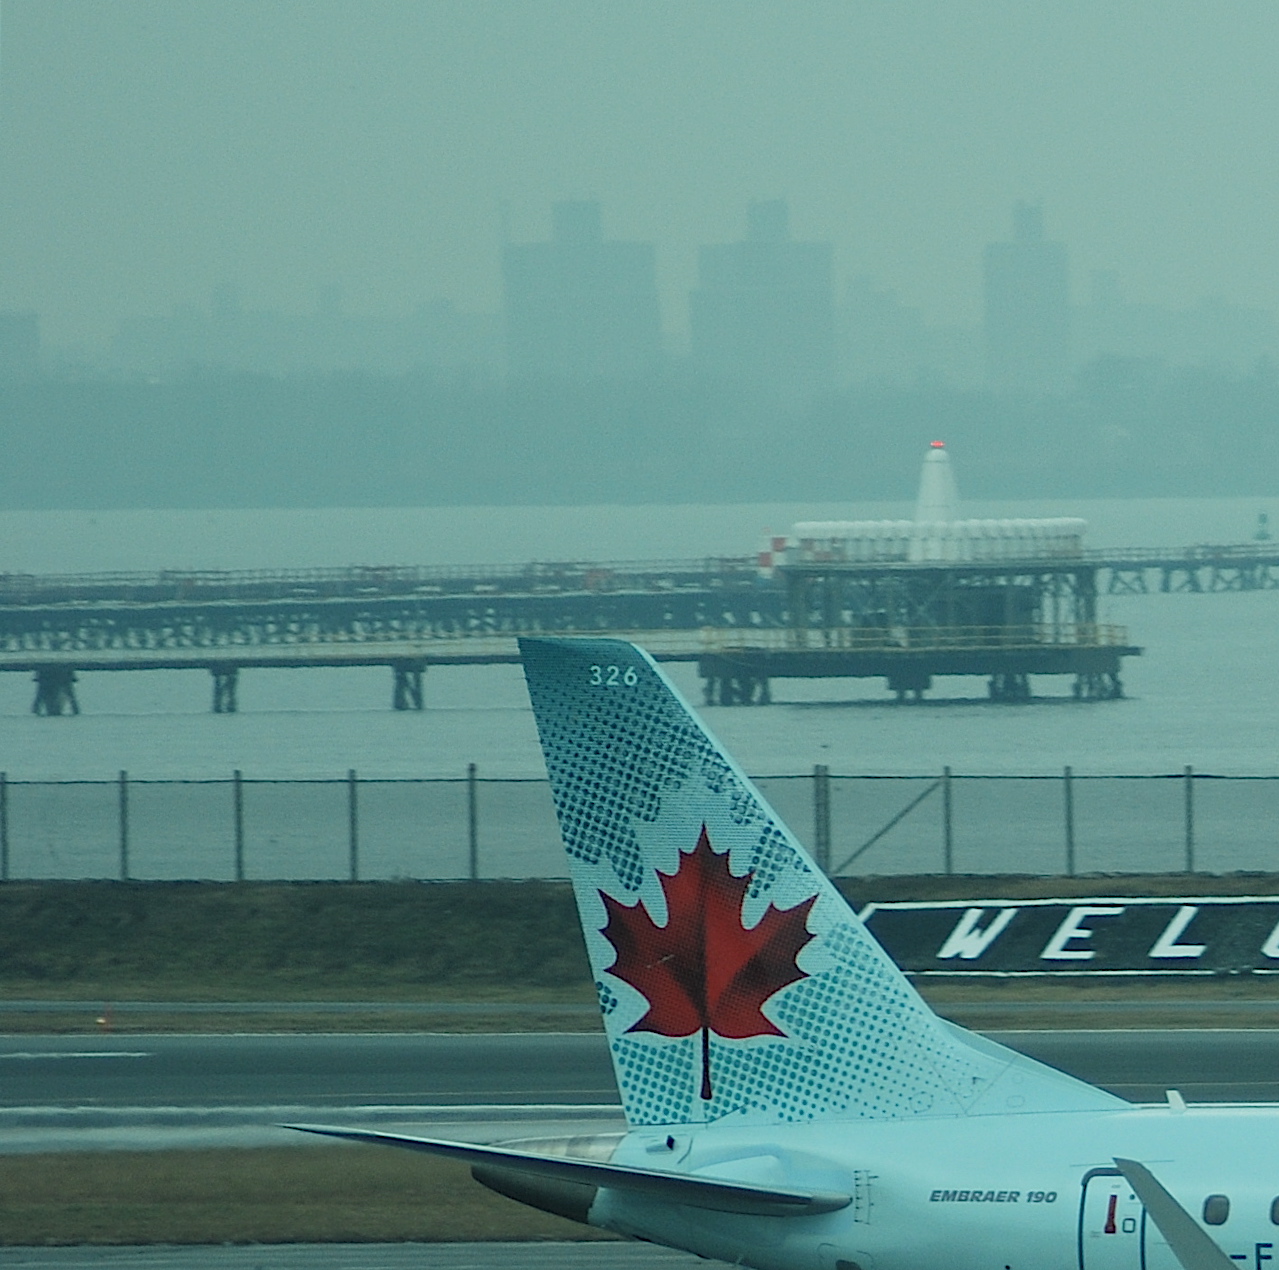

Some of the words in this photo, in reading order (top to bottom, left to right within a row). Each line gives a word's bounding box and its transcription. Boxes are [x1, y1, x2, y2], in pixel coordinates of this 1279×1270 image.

[590, 665, 638, 686] 326
[929, 1189, 1021, 1204] EMBRAER
[1026, 1190, 1058, 1205] 190
